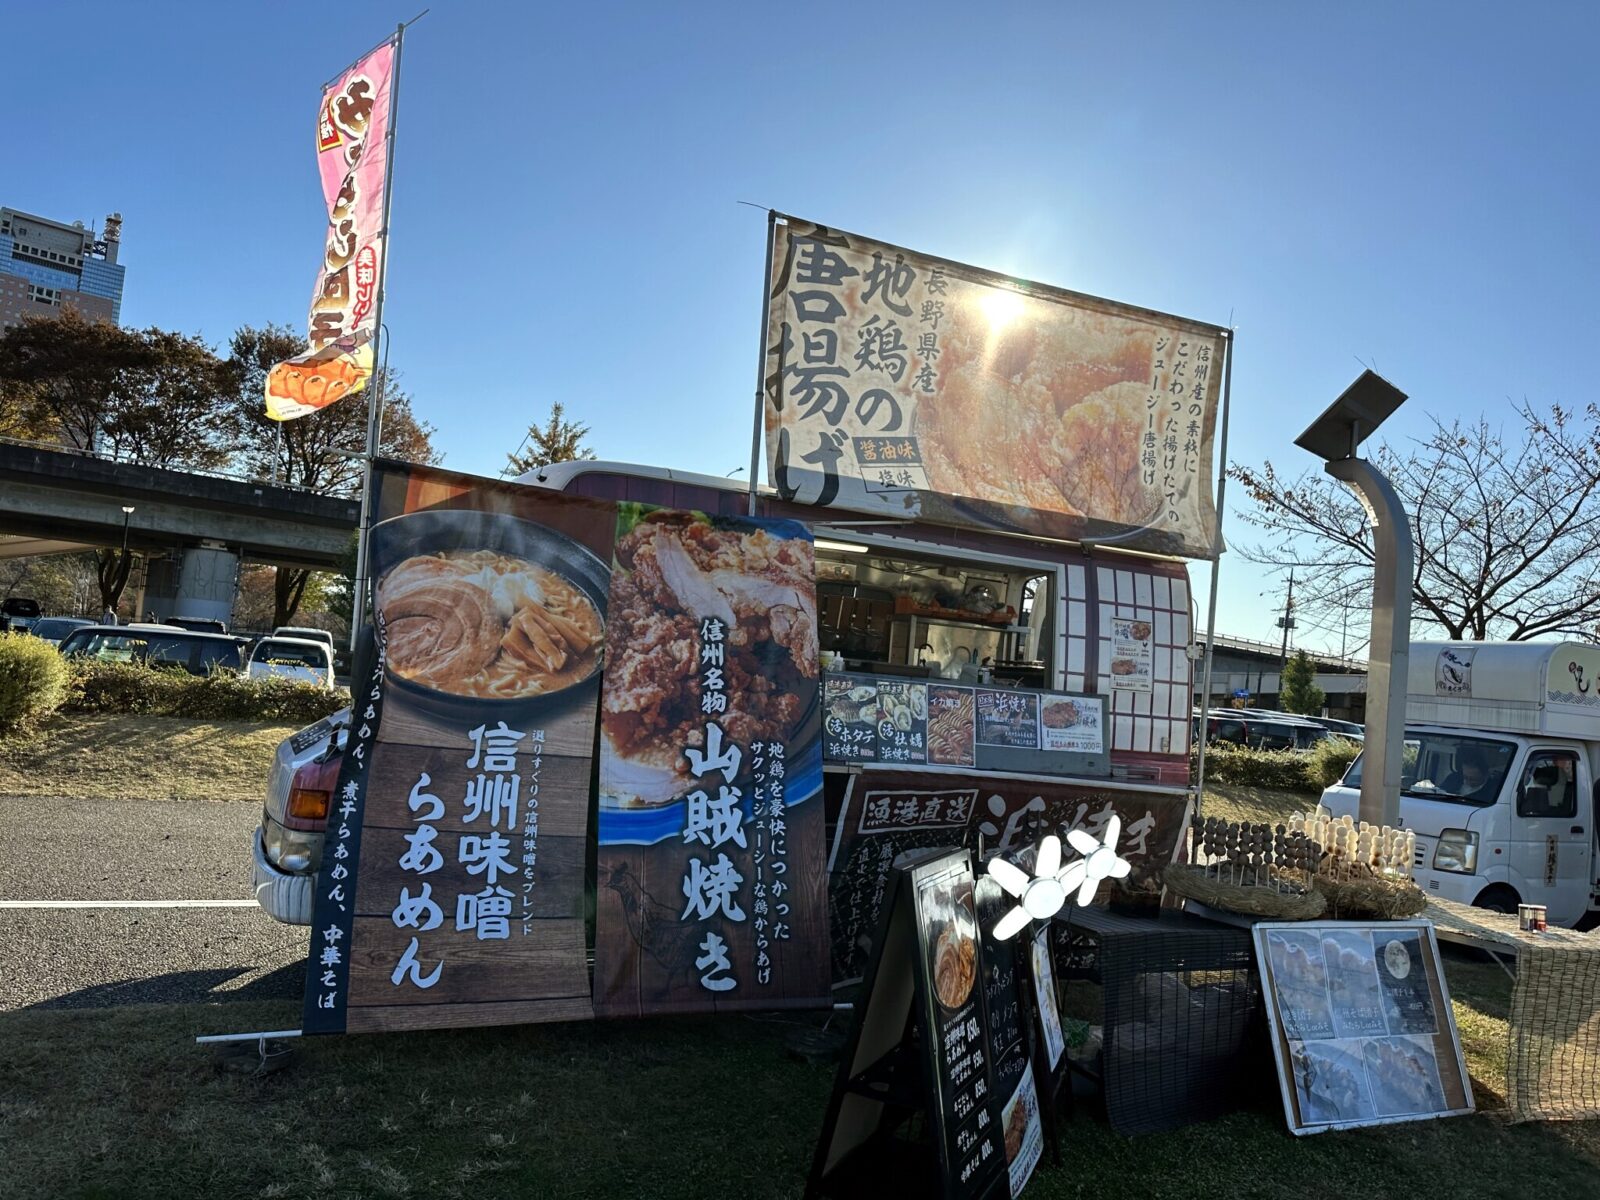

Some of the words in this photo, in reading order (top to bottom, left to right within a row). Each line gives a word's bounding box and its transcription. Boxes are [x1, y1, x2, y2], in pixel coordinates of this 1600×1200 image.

[765, 223, 860, 506] 唐揚げ
[854, 251, 917, 432] 地鶏の
[911, 266, 948, 393] 長野県産
[860, 440, 917, 461] 醤油味
[878, 468, 916, 489] 塩味
[1162, 341, 1188, 522] こだわった揚げたての
[701, 618, 727, 714] 信州名物
[840, 729, 875, 744] ホタテ
[327, 780, 360, 912] 煮干らあめん、
[391, 772, 446, 989] らあめん
[455, 721, 527, 941] 信州味噌
[522, 729, 546, 937] 選りすぐりの信州味噌をブレンド
[681, 722, 748, 992] 山賊焼き
[750, 741, 772, 985] サクッとジューシーな鶏からあげ
[768, 742, 791, 940] 地鶏を豪快につかった
[866, 795, 970, 826] 漁港直送
[317, 924, 344, 1008] 中華そば
